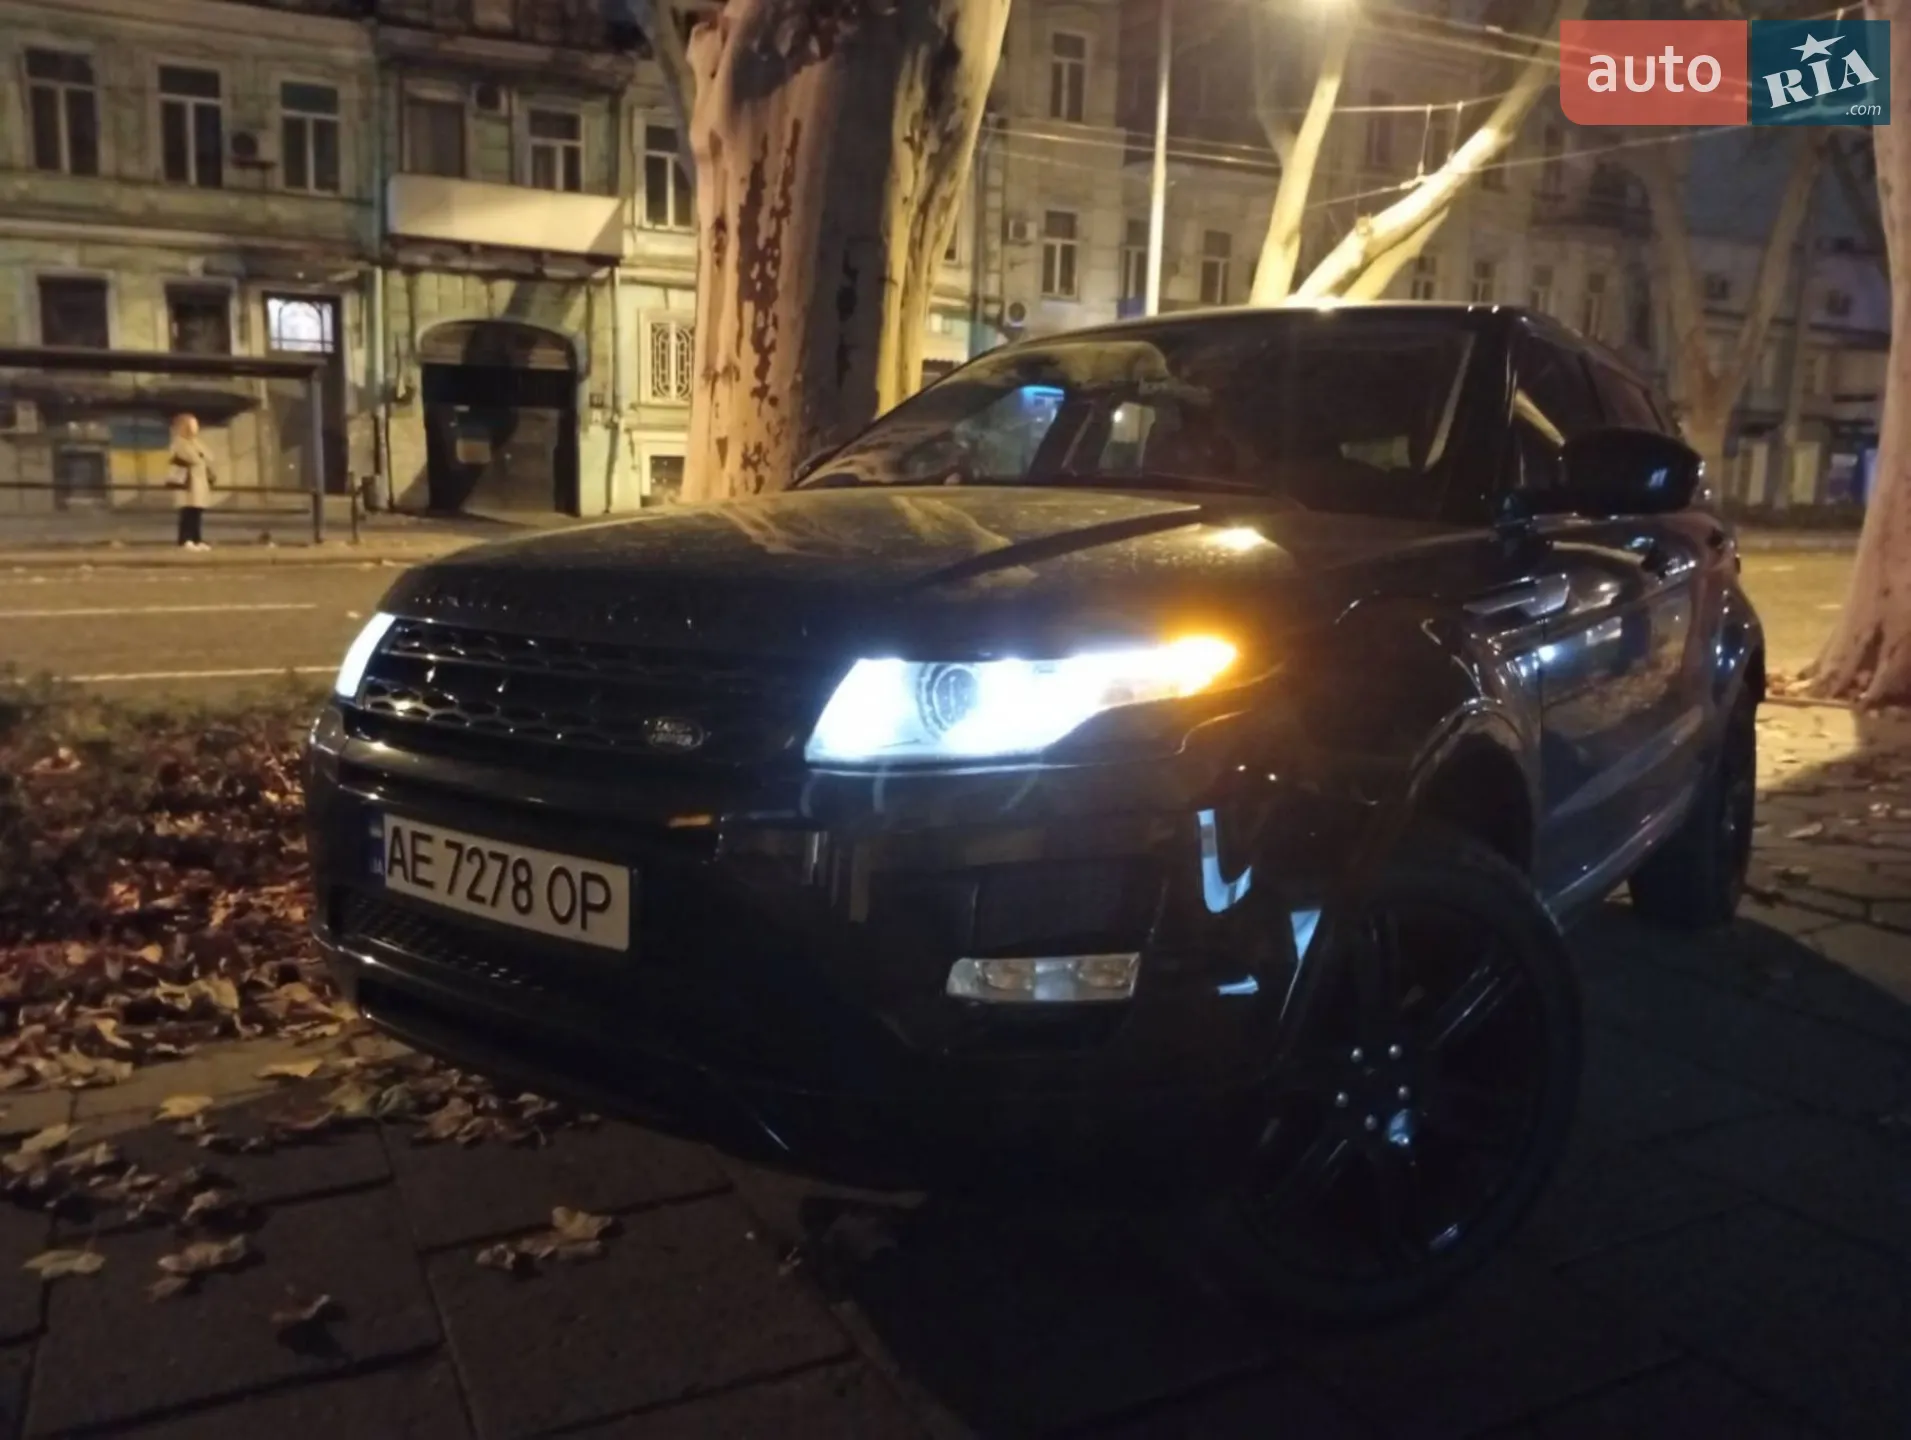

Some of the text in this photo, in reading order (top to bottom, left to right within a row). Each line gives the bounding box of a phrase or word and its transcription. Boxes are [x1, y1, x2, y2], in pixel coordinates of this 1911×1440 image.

[387, 825, 612, 931] AE 7278 OP
